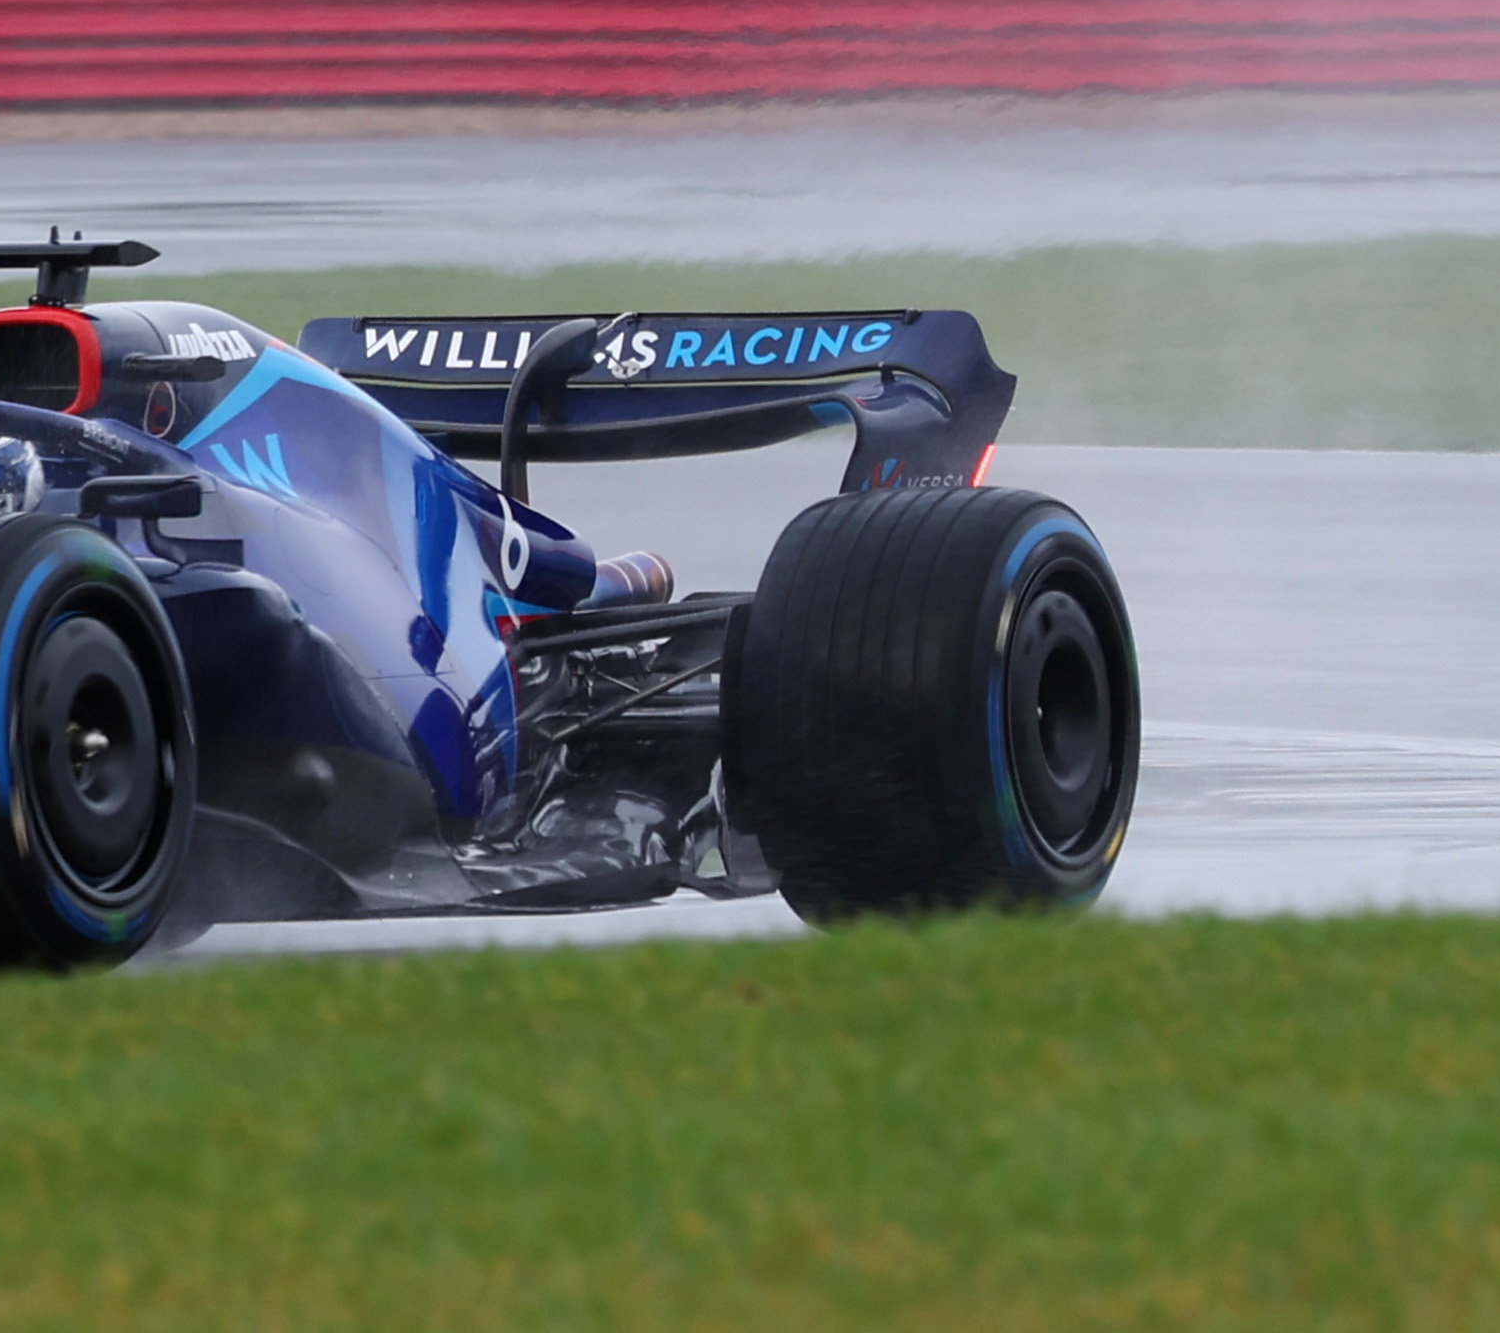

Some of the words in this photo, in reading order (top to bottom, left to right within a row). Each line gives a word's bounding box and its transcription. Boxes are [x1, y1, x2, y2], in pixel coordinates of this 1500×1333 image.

[167, 322, 257, 362] LAVAZZA
[364, 328, 659, 370] WILLIS
[665, 321, 893, 369] RACING
[496, 493, 530, 591] 6
